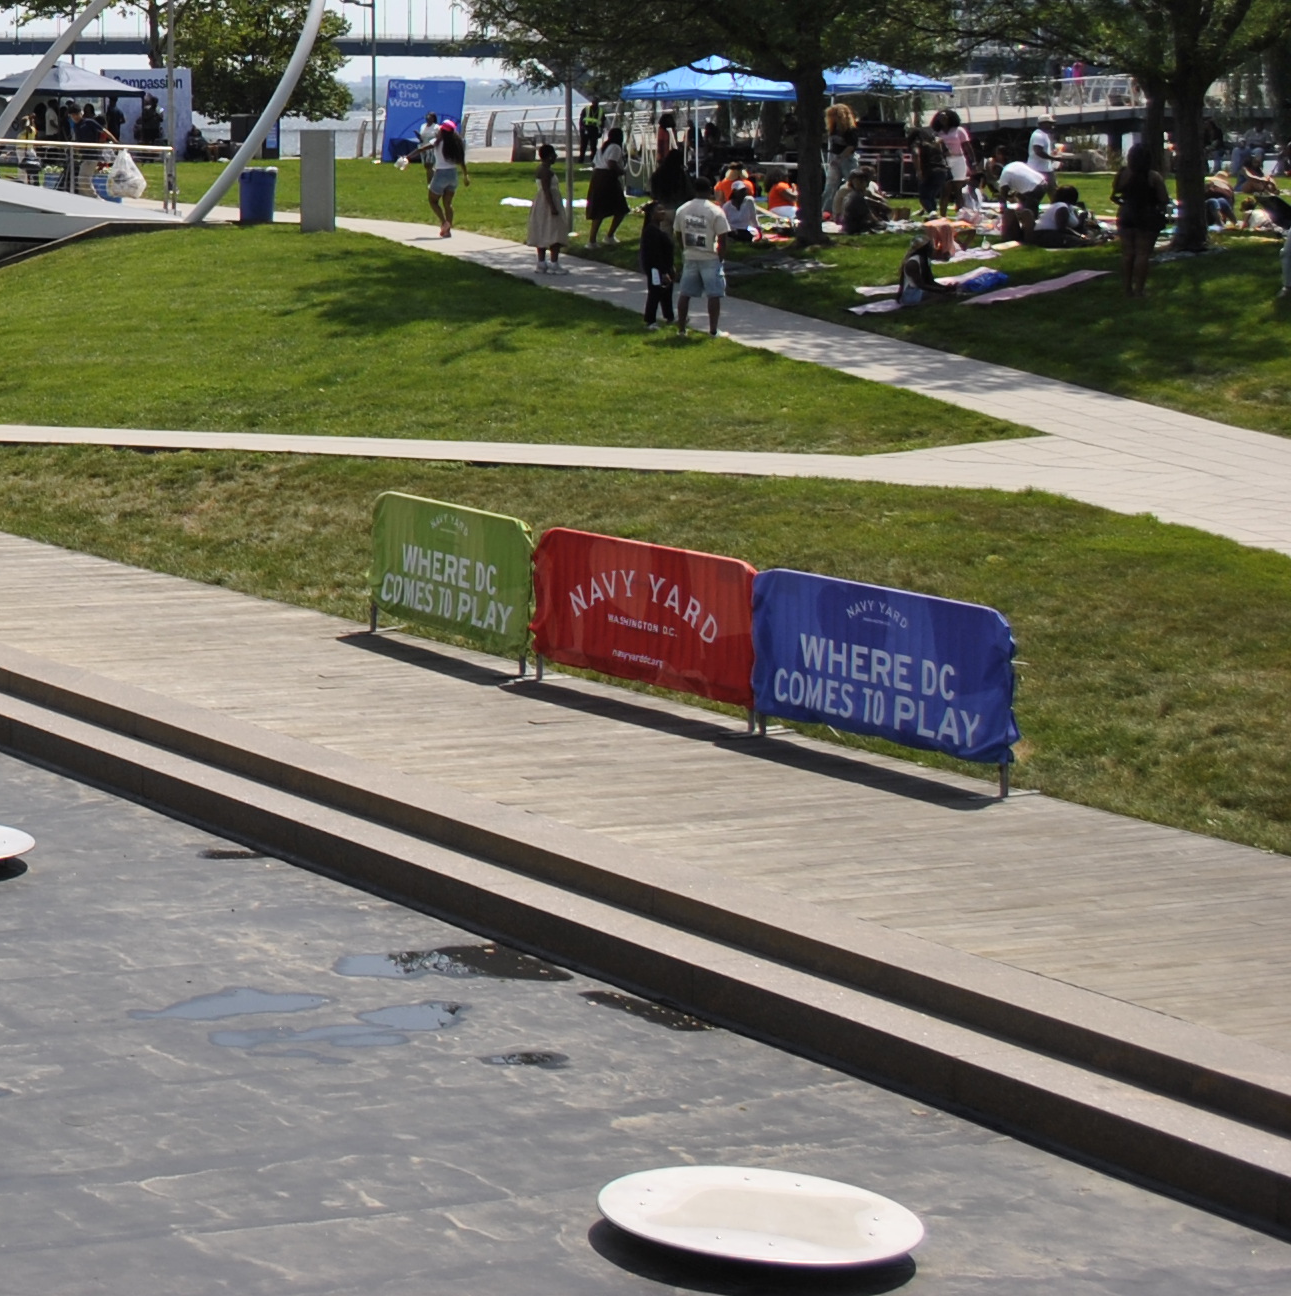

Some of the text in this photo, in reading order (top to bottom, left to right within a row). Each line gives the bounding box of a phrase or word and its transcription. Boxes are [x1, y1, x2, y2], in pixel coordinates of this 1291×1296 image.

[113, 75, 183, 89] Compassin
[389, 81, 424, 90] Know
[398, 90, 419, 99] the
[389, 98, 425, 108] Word.
[430, 513, 469, 537] NAVY YARD
[402, 543, 497, 596] WHERE DC
[381, 572, 514, 634] COMES TO PLAY
[569, 569, 718, 644] NAVY YARD
[845, 599, 908, 629] NAVY YARD
[607, 613, 678, 638] WASHINGTON D.C.
[800, 633, 956, 701] WHERE DC
[774, 667, 981, 748] COMES TO PLAY
